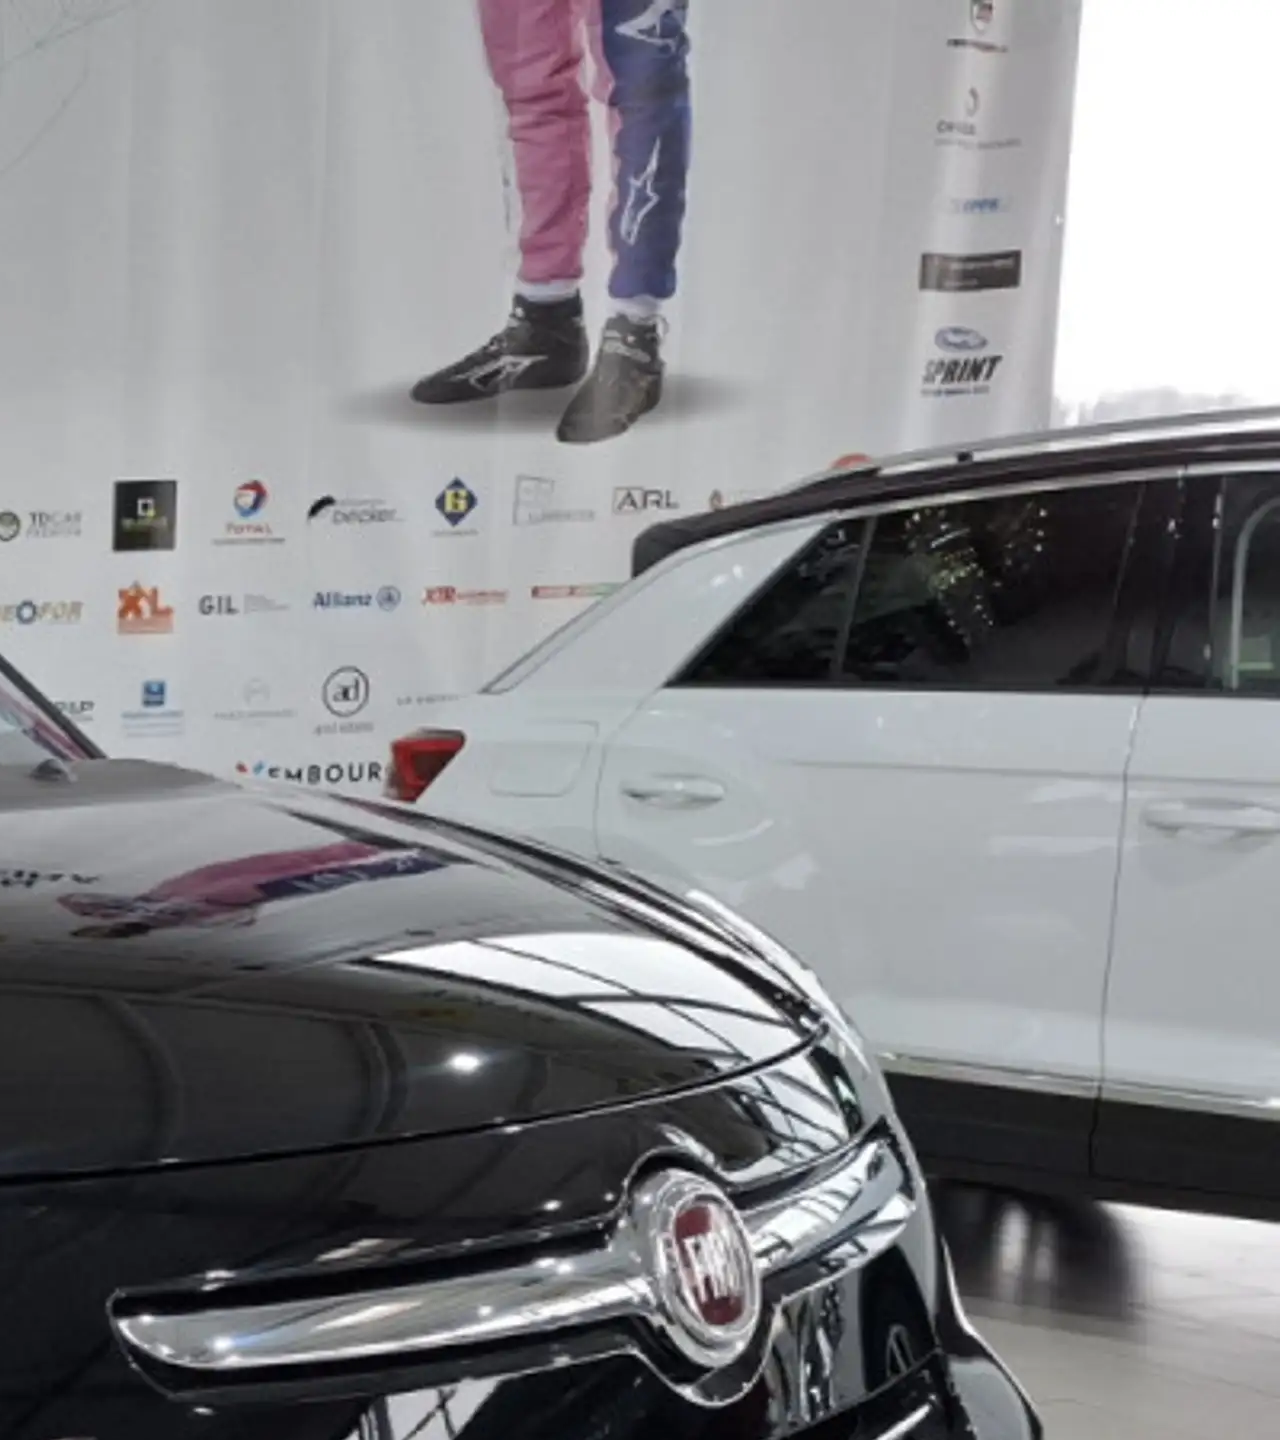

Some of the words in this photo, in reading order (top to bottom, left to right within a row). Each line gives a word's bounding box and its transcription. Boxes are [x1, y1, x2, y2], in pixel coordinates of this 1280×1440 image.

[923, 354, 1003, 385] SPRINT
[616, 489, 679, 511] ARL
[198, 595, 239, 616] GIL
[313, 591, 372, 608] Allianz
